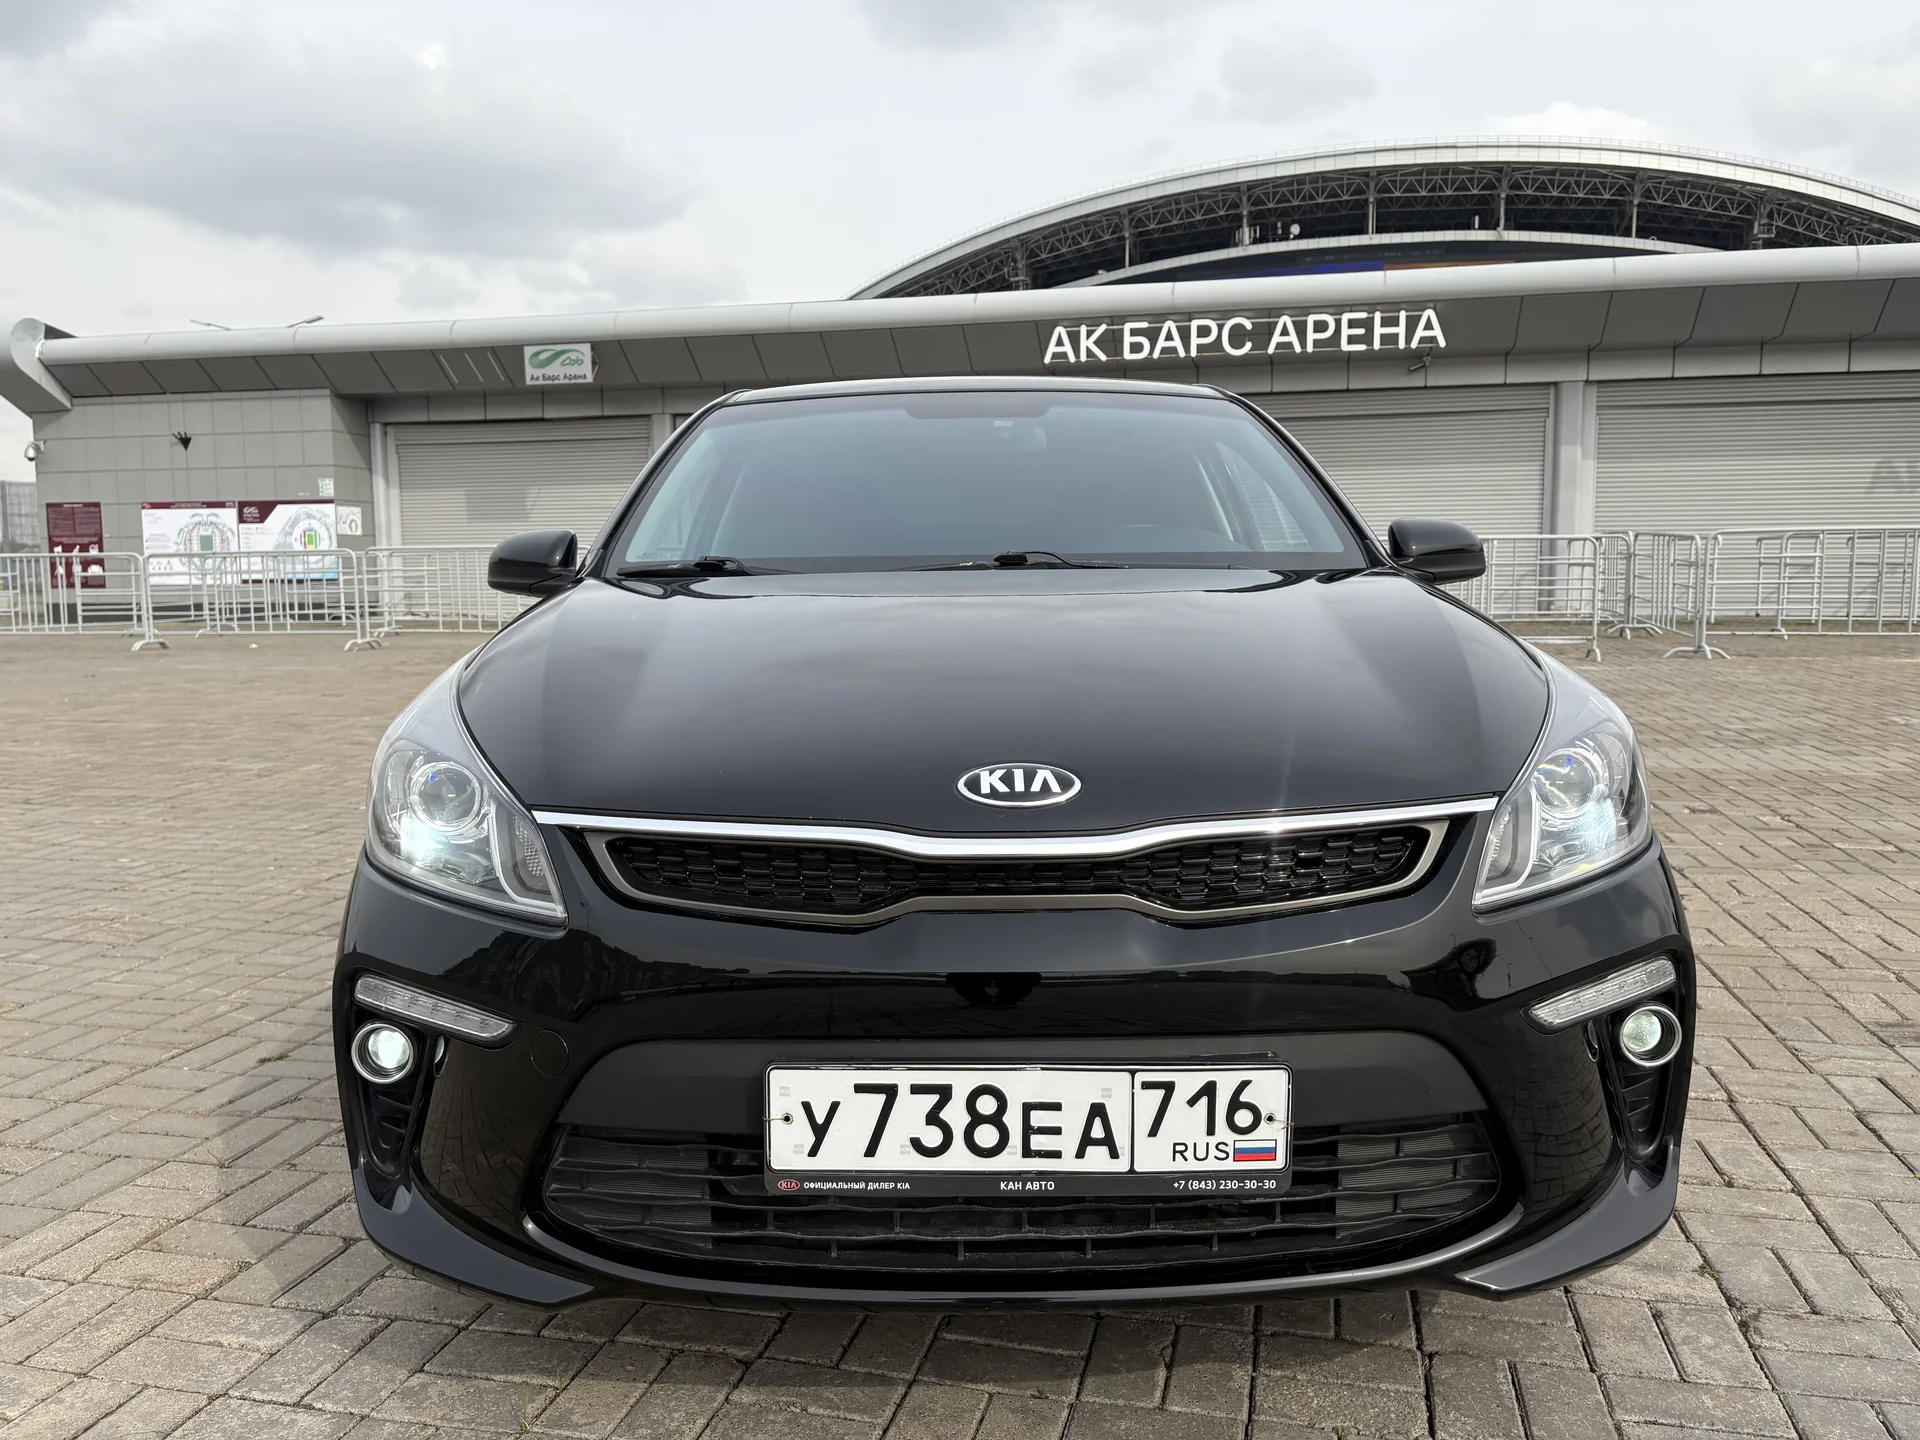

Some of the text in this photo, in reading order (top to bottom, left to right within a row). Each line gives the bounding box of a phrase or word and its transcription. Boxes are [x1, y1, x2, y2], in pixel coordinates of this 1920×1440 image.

[1044, 308, 1446, 364] АК БАРС АРЕНА
[542, 373, 561, 382] Барс
[562, 372, 588, 381] Арена
[979, 768, 1062, 794] KIA
[1141, 1079, 1263, 1138] 716
[1172, 1141, 1230, 1162] RUS
[803, 1180, 911, 1190] ОФИЦИАЛЬНЫЙ ДИЛЕР KIA
[1000, 1181, 1055, 1191] КАН АВТО
[1173, 1180, 1276, 1190] +7 (843) 230-30-30
